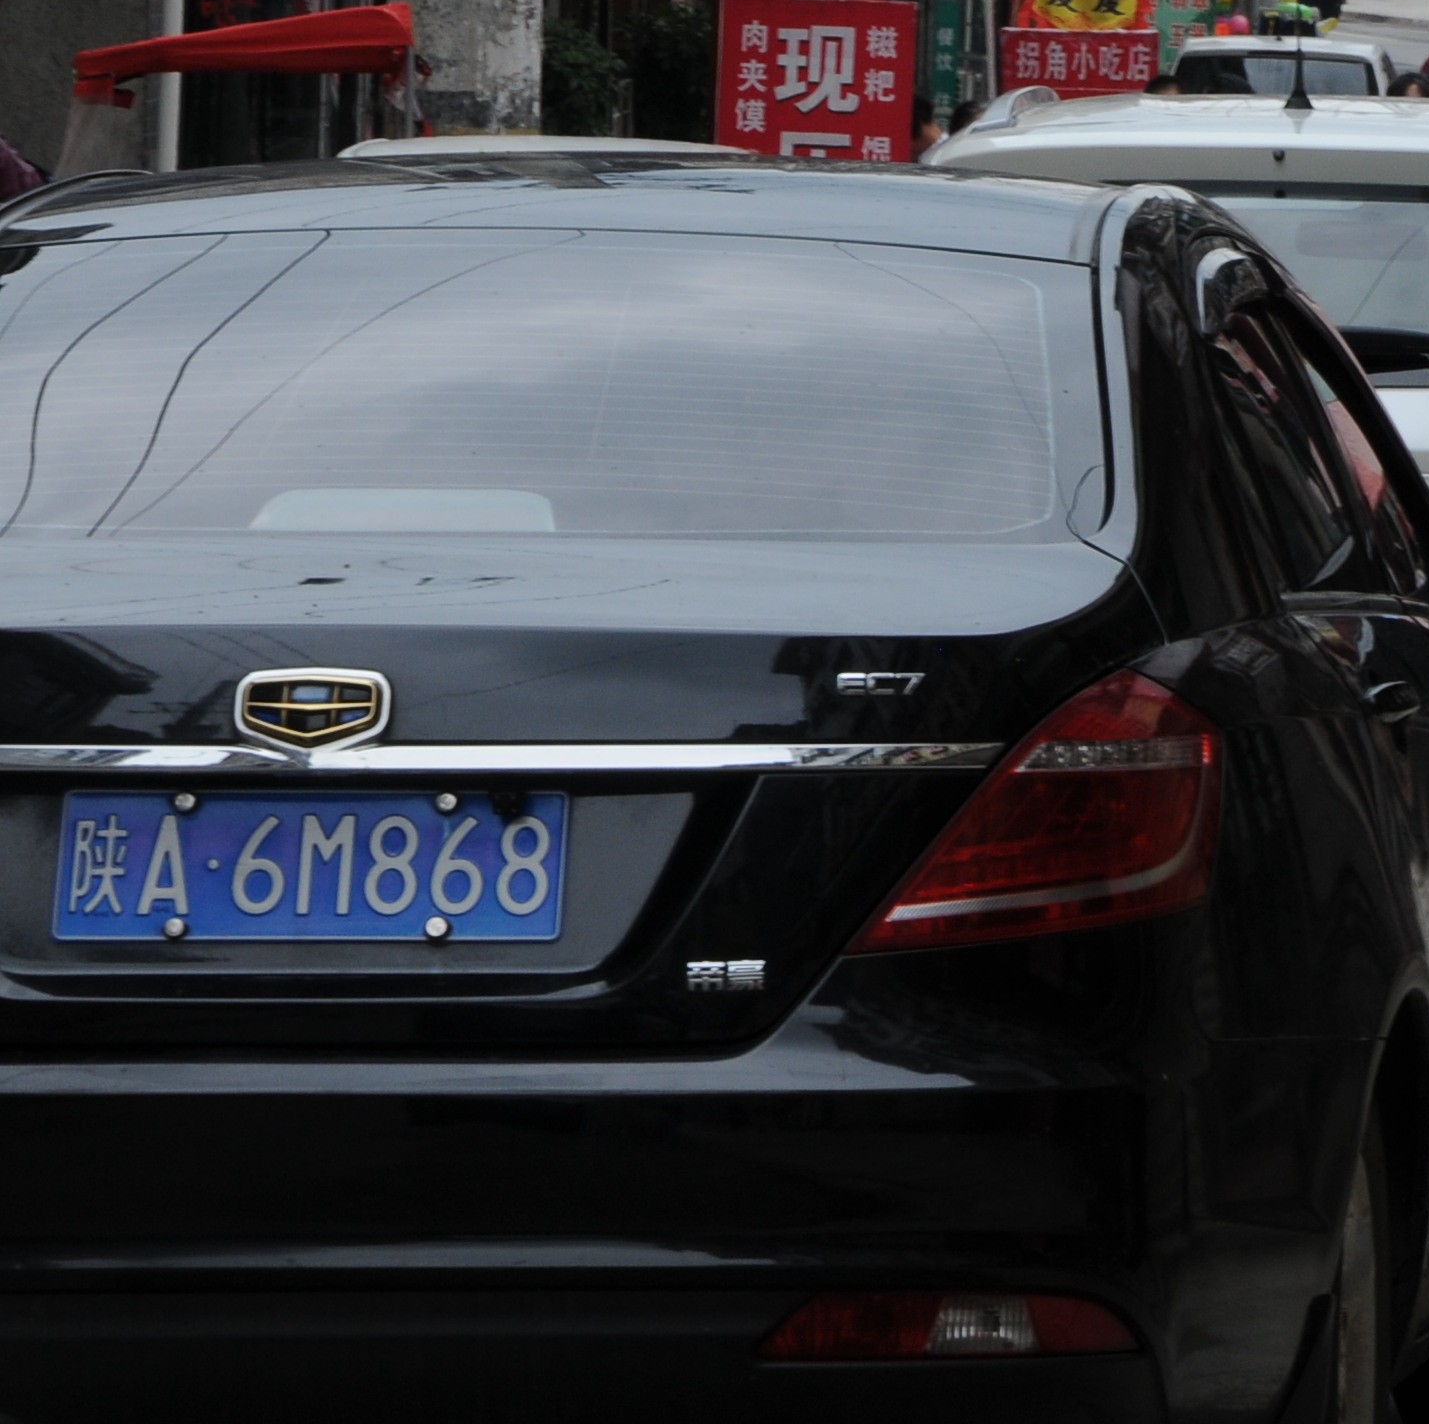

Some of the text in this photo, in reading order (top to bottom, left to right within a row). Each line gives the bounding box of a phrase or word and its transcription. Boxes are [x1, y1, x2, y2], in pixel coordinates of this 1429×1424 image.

[734, 19, 769, 134] 肉夹馍
[773, 25, 861, 158] 现
[1015, 39, 1153, 83] 拐角小吃店
[837, 671, 927, 696] EC7
[68, 814, 552, 918] 陕A·6M868
